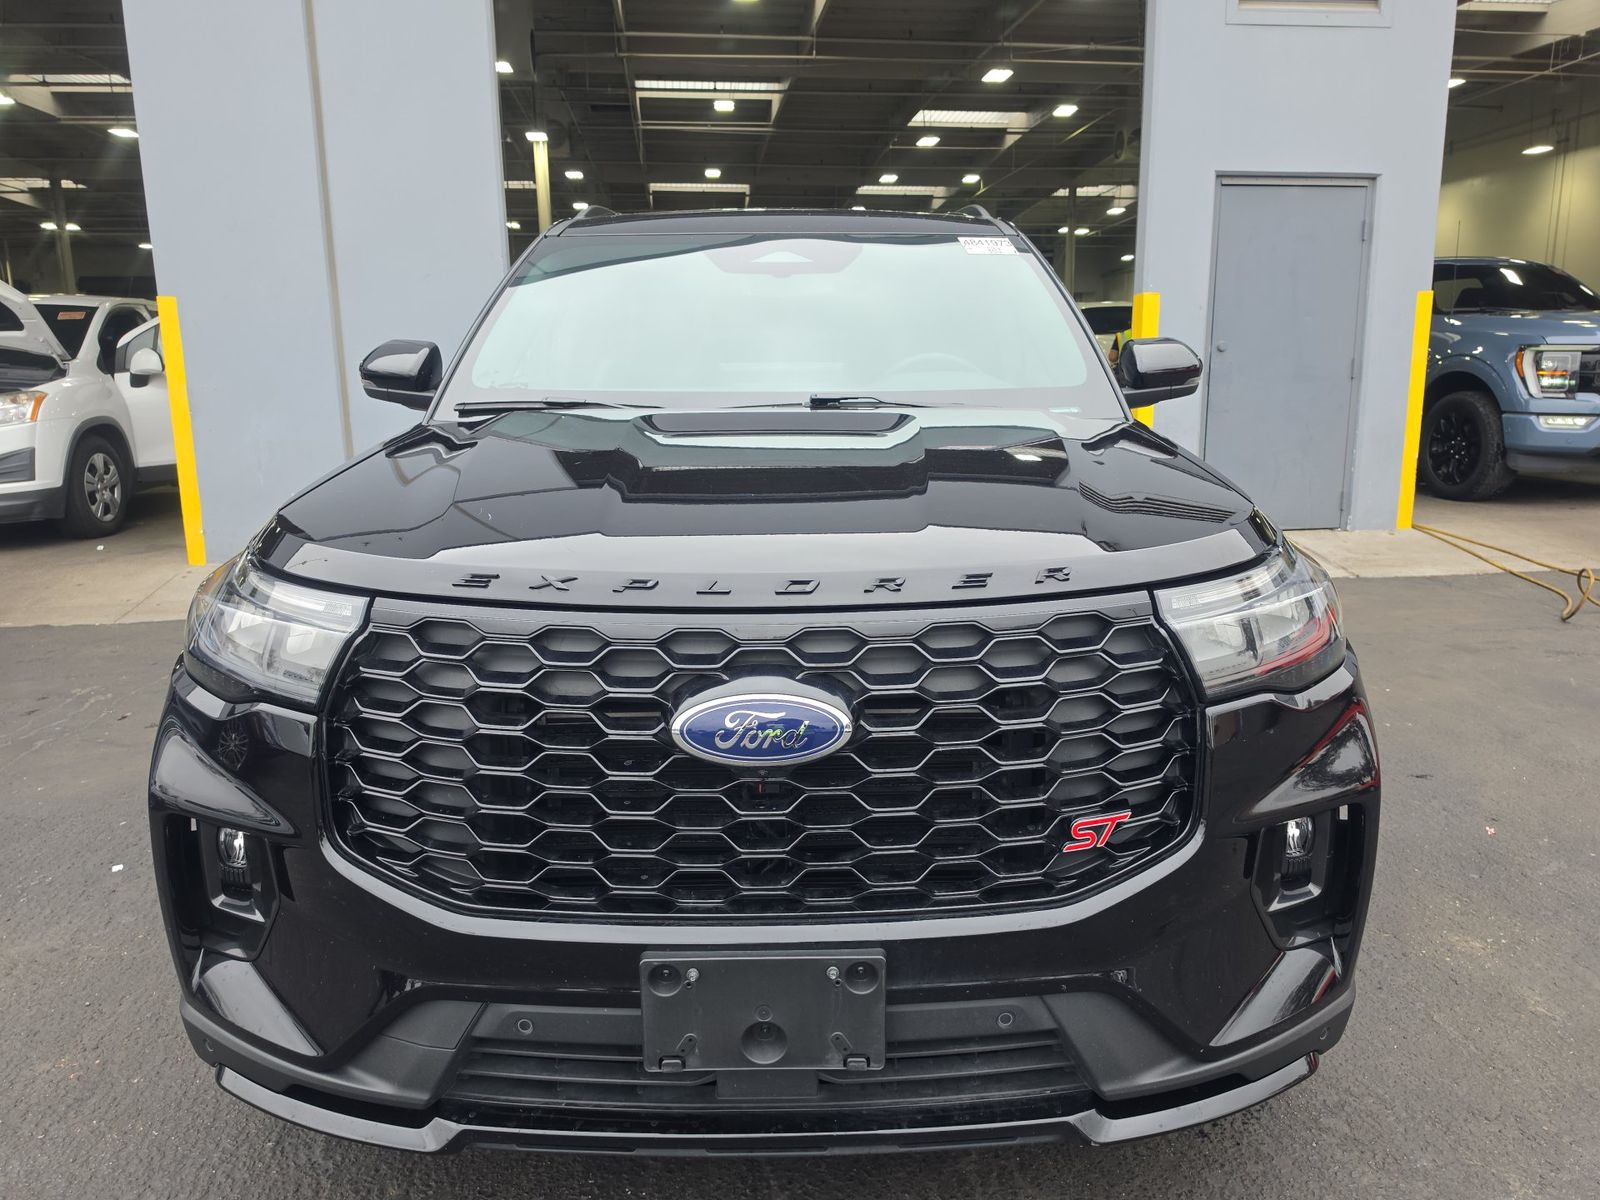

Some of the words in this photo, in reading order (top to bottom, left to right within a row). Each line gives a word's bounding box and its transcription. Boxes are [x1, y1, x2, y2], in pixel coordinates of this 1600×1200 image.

[451, 565, 1072, 595] EXPLORER
[714, 710, 810, 750] Ford
[1062, 811, 1132, 853] ST
